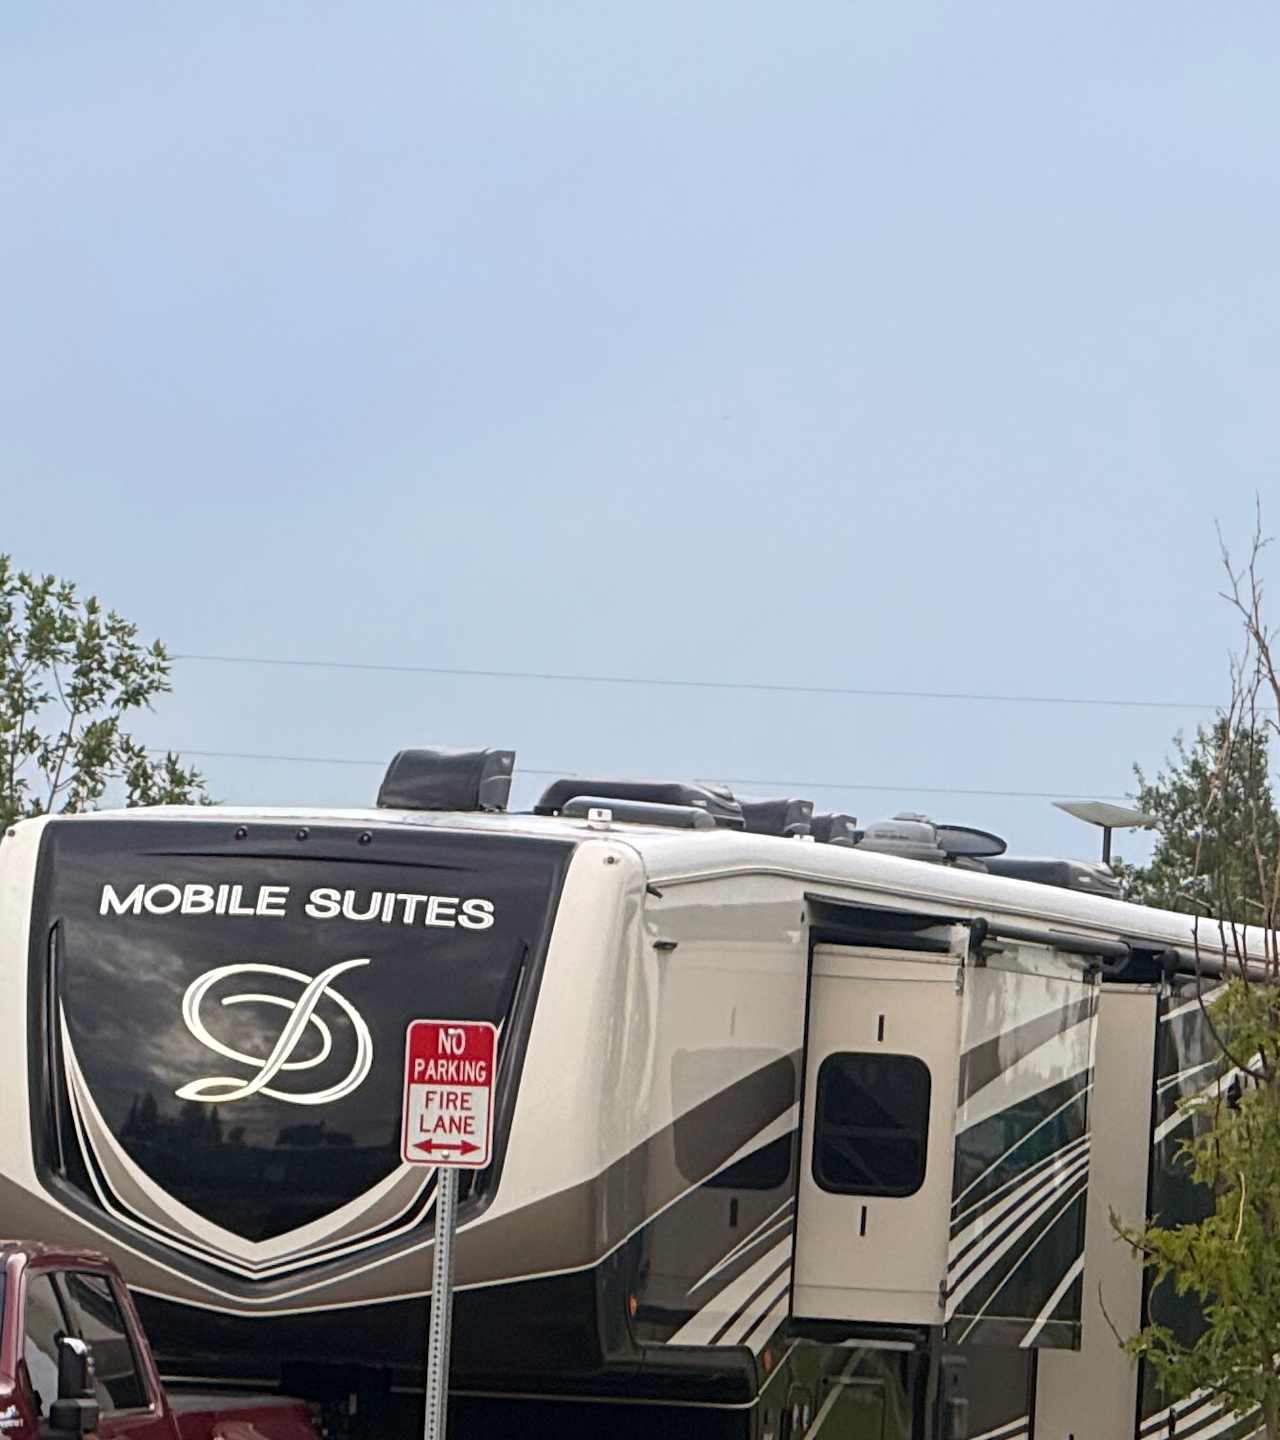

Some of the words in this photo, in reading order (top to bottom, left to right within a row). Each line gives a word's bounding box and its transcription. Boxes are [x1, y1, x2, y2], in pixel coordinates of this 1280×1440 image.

[99, 884, 290, 917] MOBILE
[305, 888, 495, 930] SUITES
[438, 1028, 466, 1055] NO
[414, 1058, 487, 1082] PARKING
[425, 1090, 473, 1111] FIRE
[420, 1114, 475, 1135] LANE
